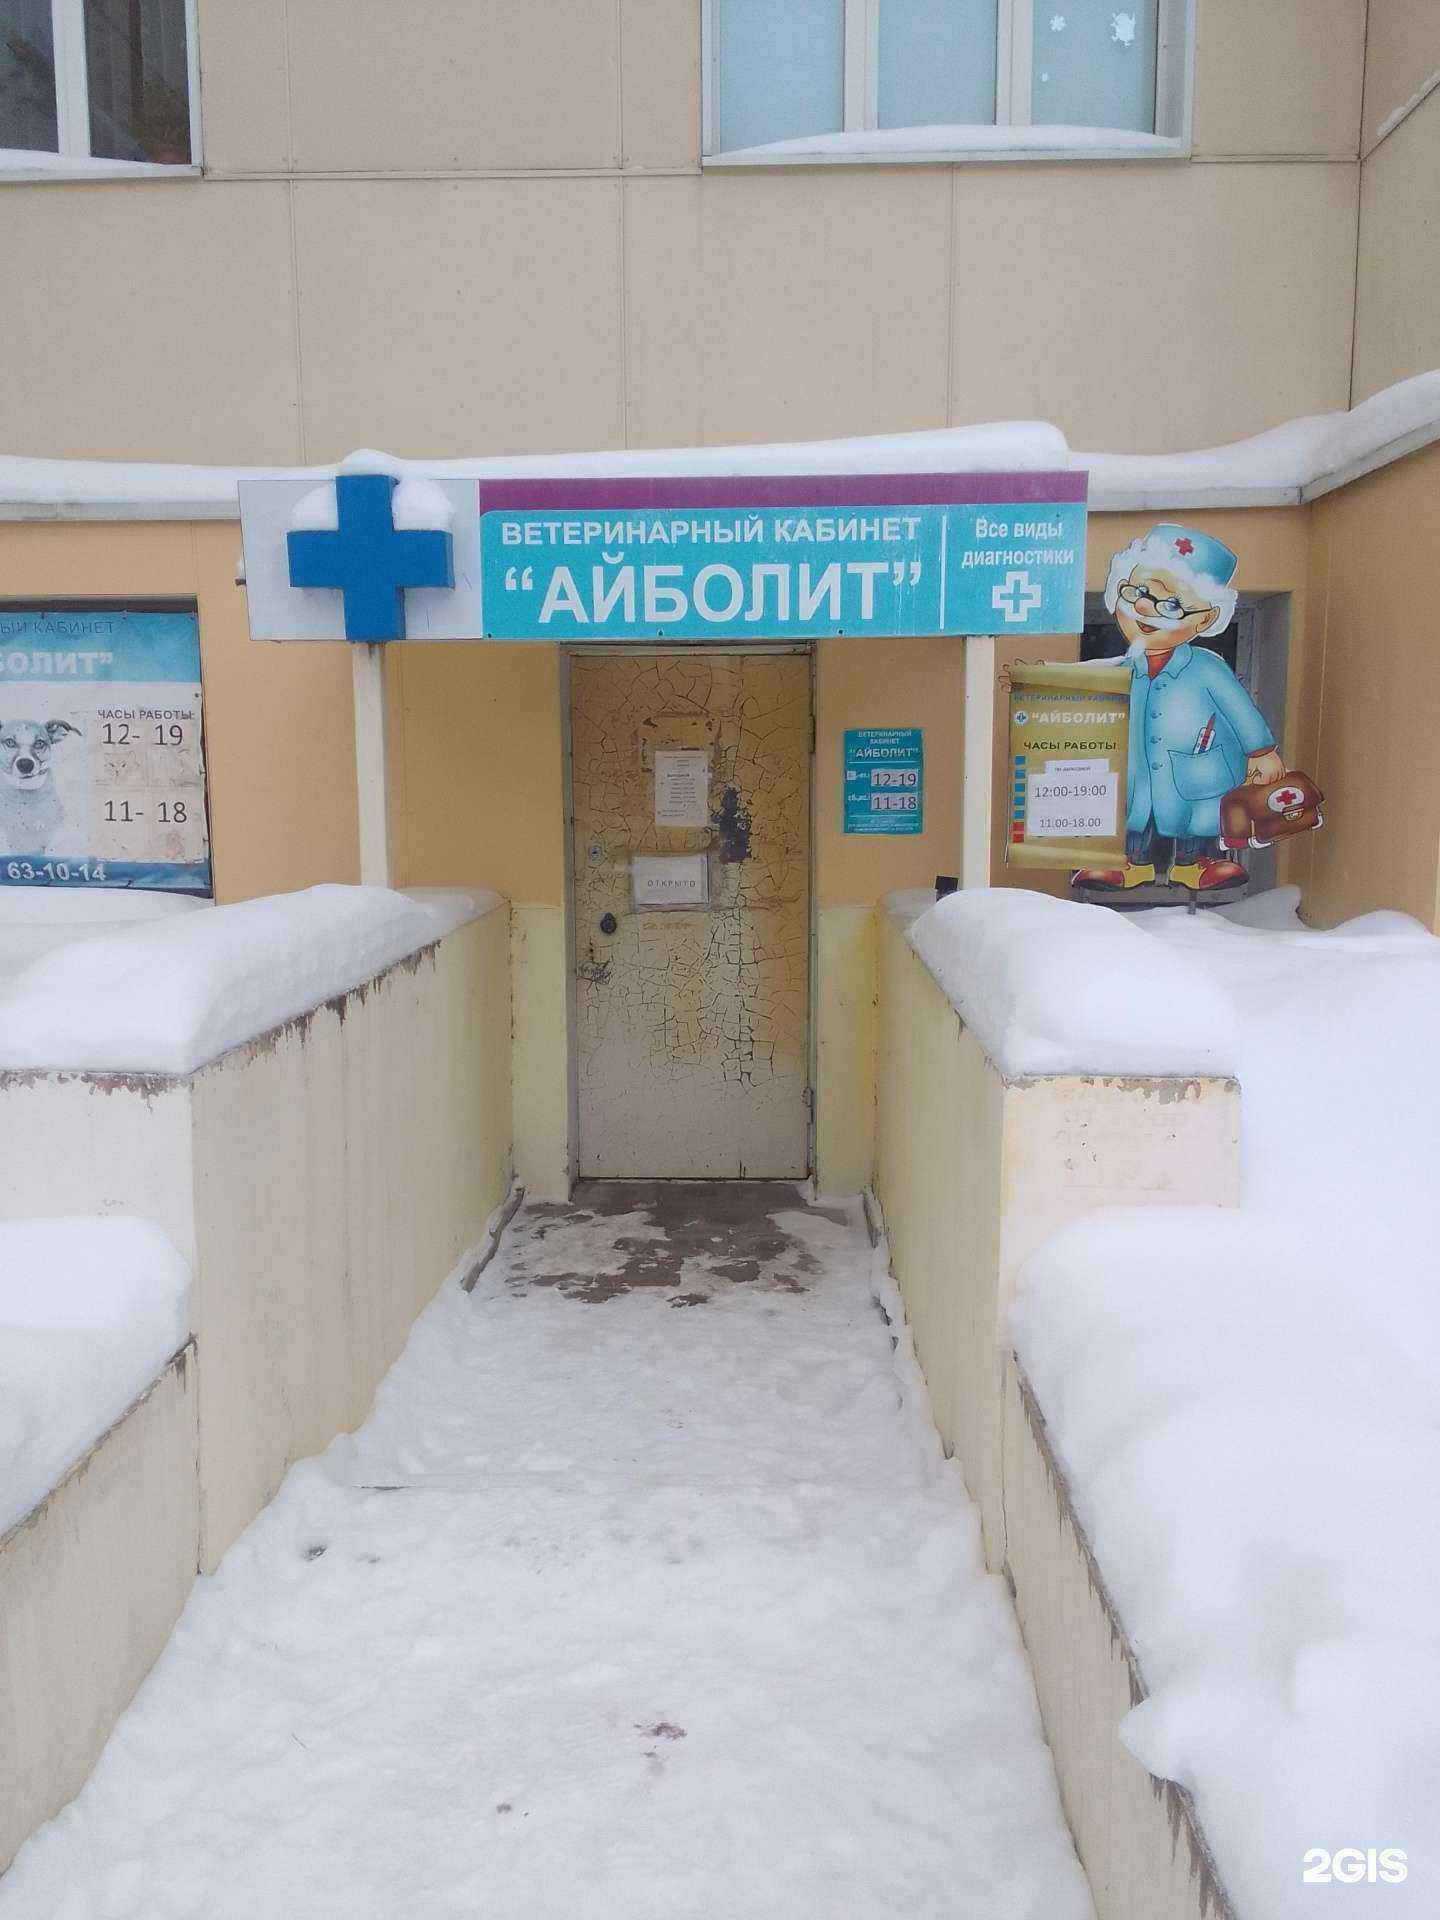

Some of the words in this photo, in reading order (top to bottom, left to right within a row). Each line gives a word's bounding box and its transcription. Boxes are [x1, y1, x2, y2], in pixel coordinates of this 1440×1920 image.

[502, 513, 764, 545] ВЕТЕРИНАРНЫЙ
[773, 516, 922, 543] КАБИНЕТ
[975, 518, 1008, 538] Все
[1013, 522, 1063, 539] виды
[962, 549, 1075, 569] диагностики
[504, 551, 923, 624] “АЙБОЛИТ”
[34, 621, 114, 634] КАБИНЕТ
[97, 710, 135, 720] ЧАСЫ
[155, 725, 184, 745] 19
[1024, 742, 1060, 750] ЧАСЫ
[873, 773, 917, 786] 12-19
[1034, 785, 1107, 797] 12:00-19:00
[158, 802, 188, 822] 18
[873, 796, 917, 810] 11-18
[7, 861, 107, 881] 63-10-14
